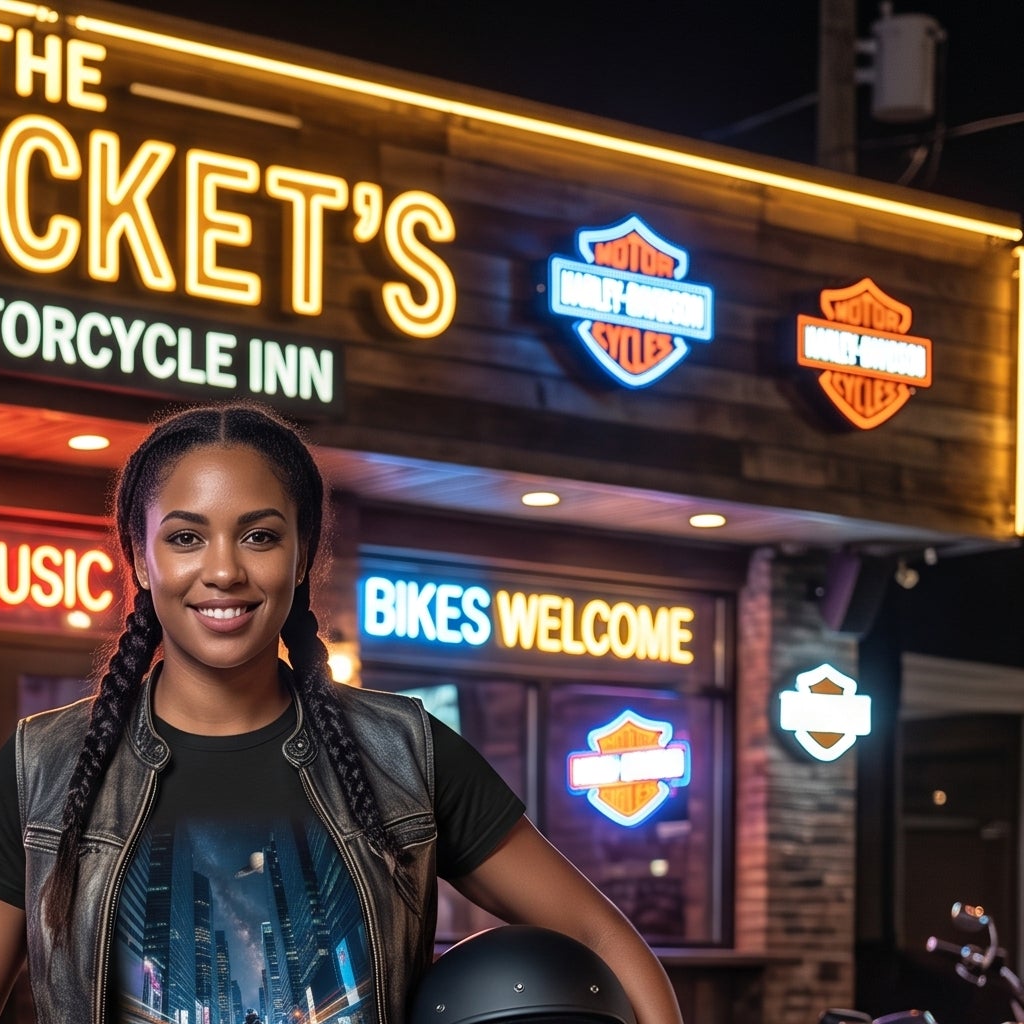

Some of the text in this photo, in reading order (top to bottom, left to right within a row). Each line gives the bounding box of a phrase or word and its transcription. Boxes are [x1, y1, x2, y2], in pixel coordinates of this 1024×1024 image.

[247, 337, 335, 404] INN
[362, 576, 696, 666] BIKES WELCOME
